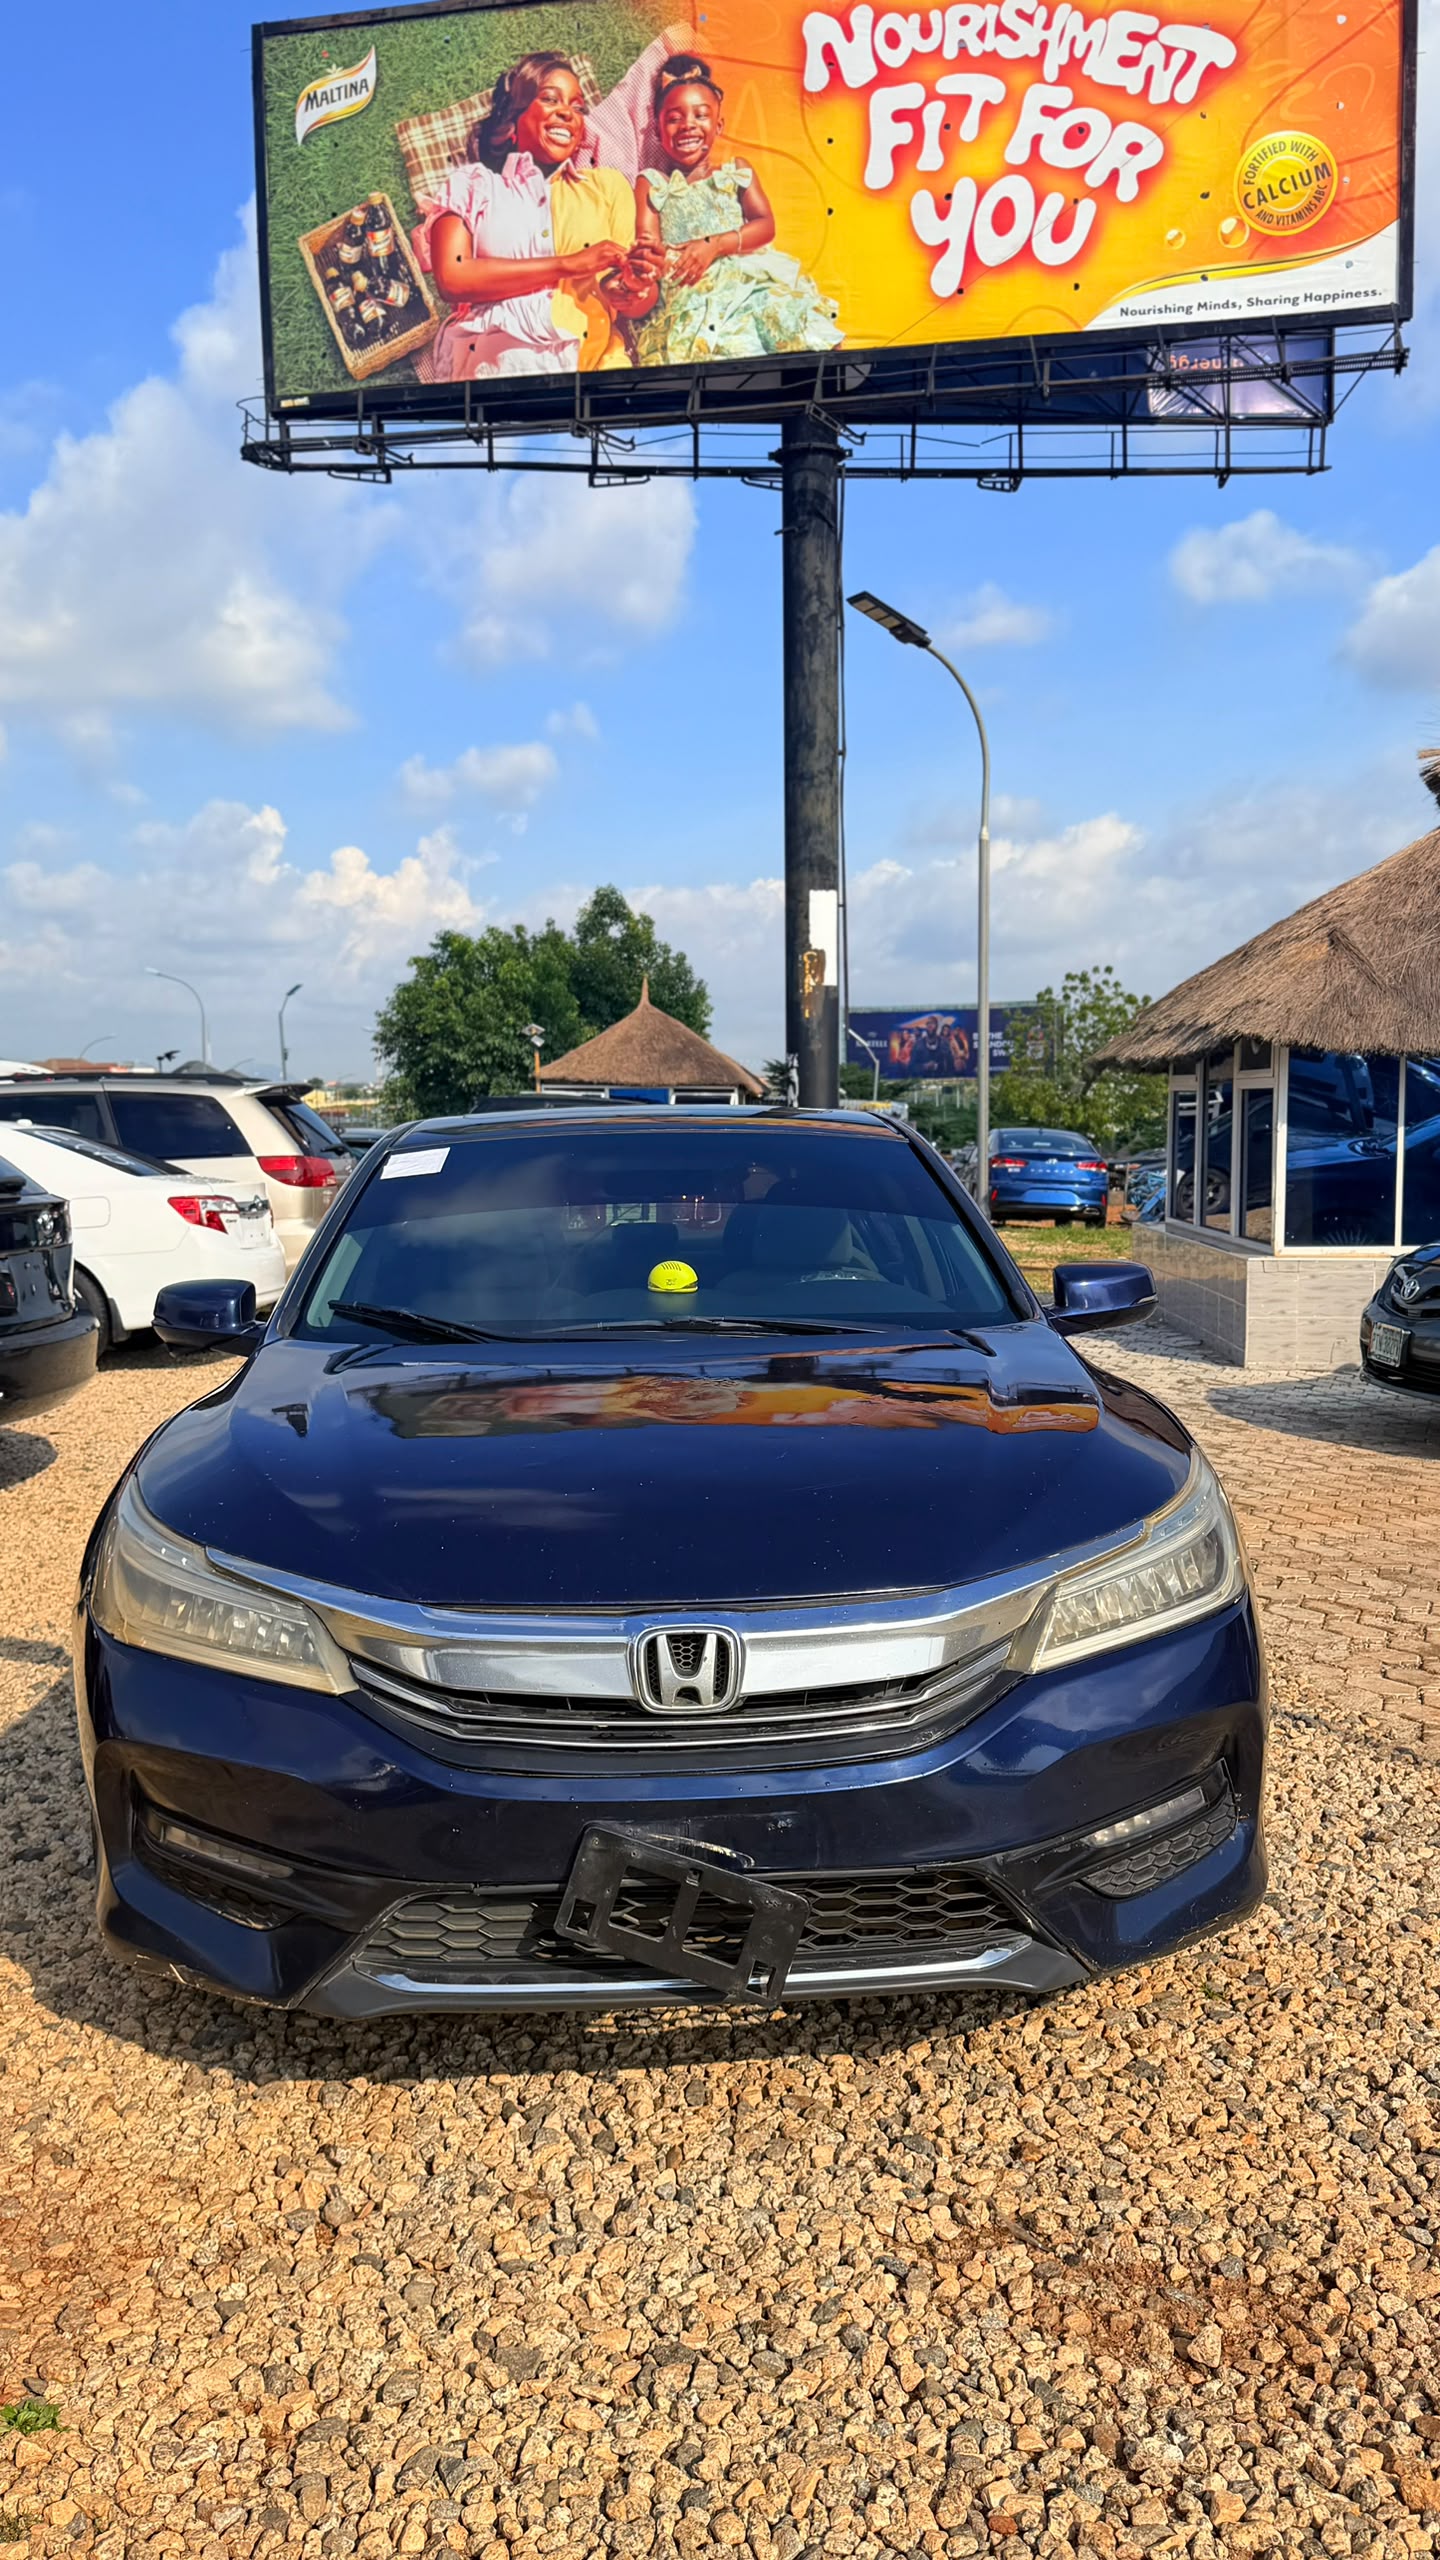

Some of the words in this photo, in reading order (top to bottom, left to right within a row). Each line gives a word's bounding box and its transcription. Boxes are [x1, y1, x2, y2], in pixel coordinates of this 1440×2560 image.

[802, 0, 1237, 105] NOURISHMENT
[304, 78, 369, 113] MALTINA
[864, 73, 1006, 189] FIT
[1004, 83, 1164, 202] FOR
[1243, 141, 1287, 186] FORTIFIED
[1290, 140, 1319, 162] WITH
[1243, 162, 1331, 209] CALCIUM
[1255, 209, 1274, 225] AND
[1276, 200, 1318, 226] VITAMINS
[1312, 184, 1328, 204] ABC
[910, 174, 1097, 297] YOU
[1120, 303, 1194, 317] Nourishing
[1197, 299, 1242, 311] Minds,
[1246, 295, 1300, 307] Sharing
[1303, 289, 1382, 304] Happiness.
